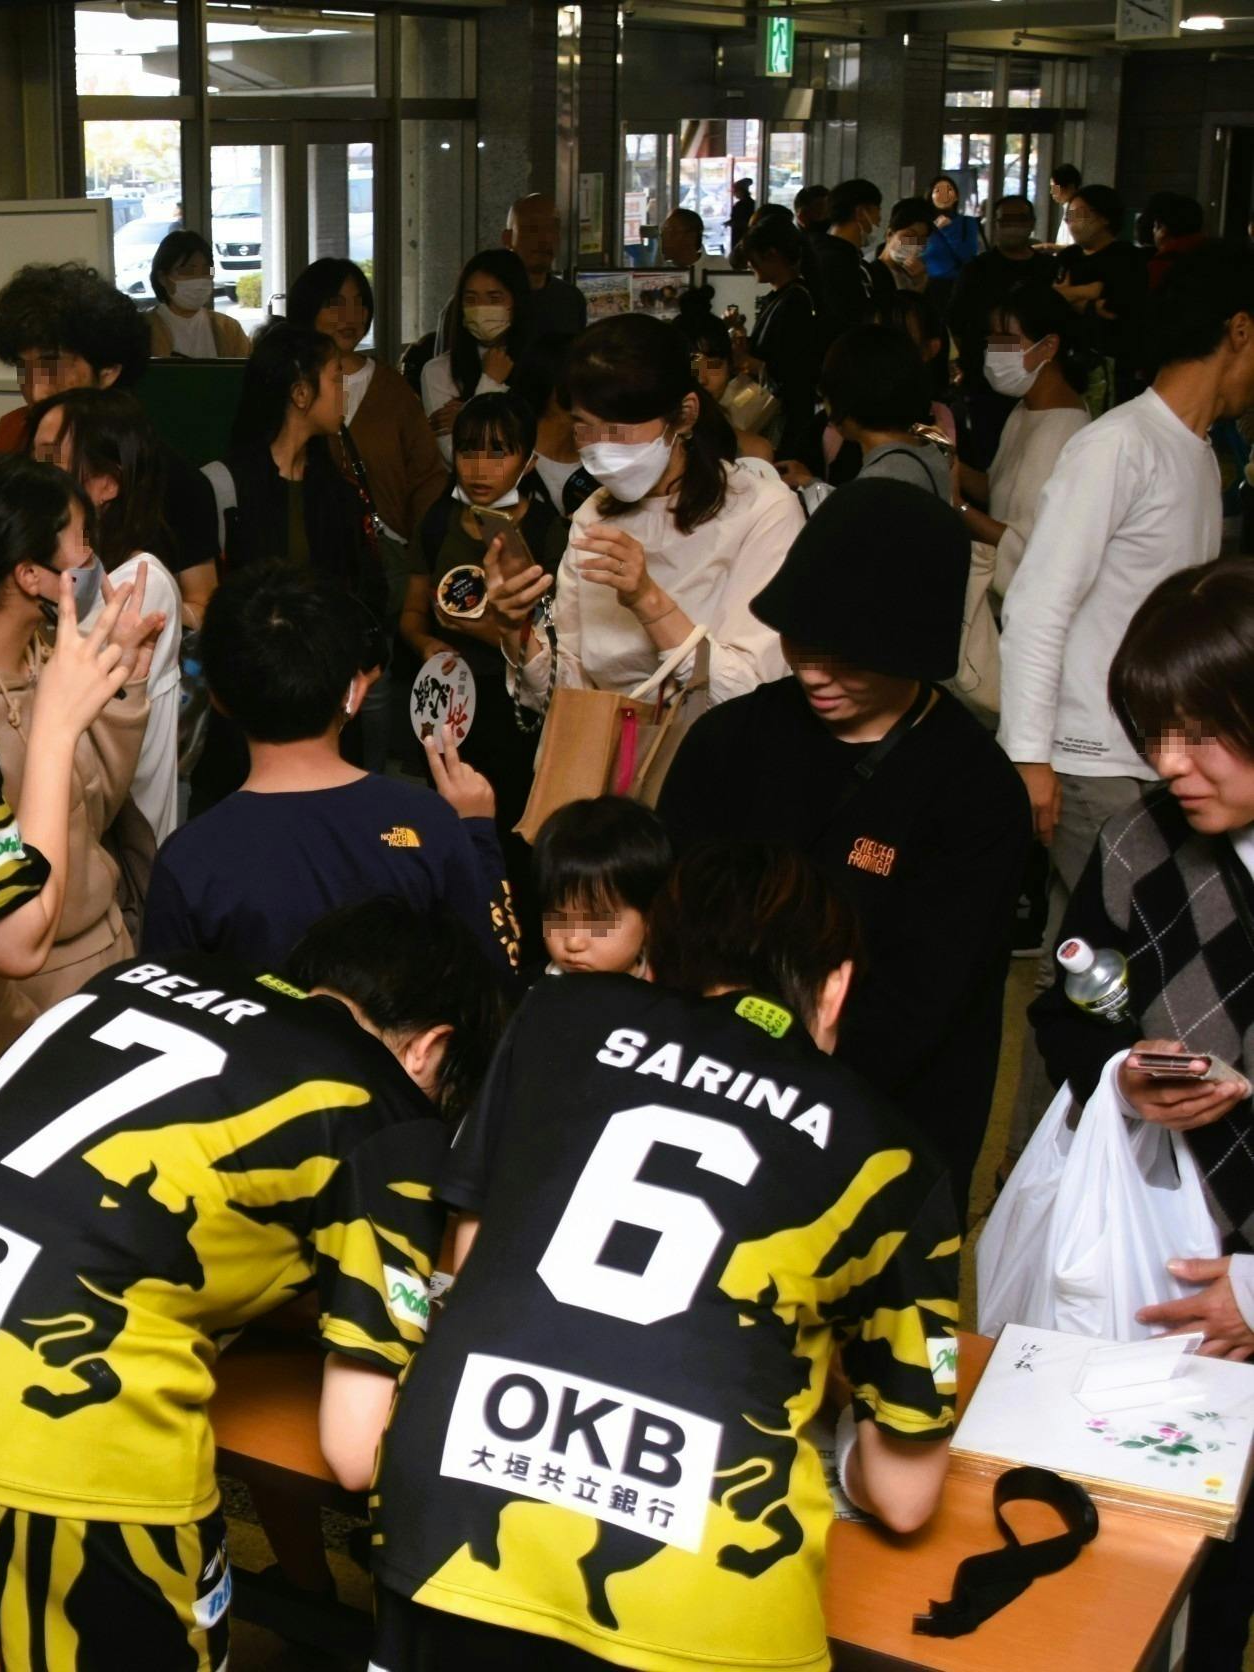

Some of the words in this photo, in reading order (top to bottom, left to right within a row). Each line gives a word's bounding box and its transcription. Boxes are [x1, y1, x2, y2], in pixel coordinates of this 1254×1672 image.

[381, 833, 407, 841] NORTH
[114, 963, 267, 1025] BEAR
[596, 1028, 832, 1150] SARINA
[536, 1104, 761, 1325] 6
[483, 1373, 686, 1488] OKB
[469, 1446, 675, 1528] 大垣共立銀行
